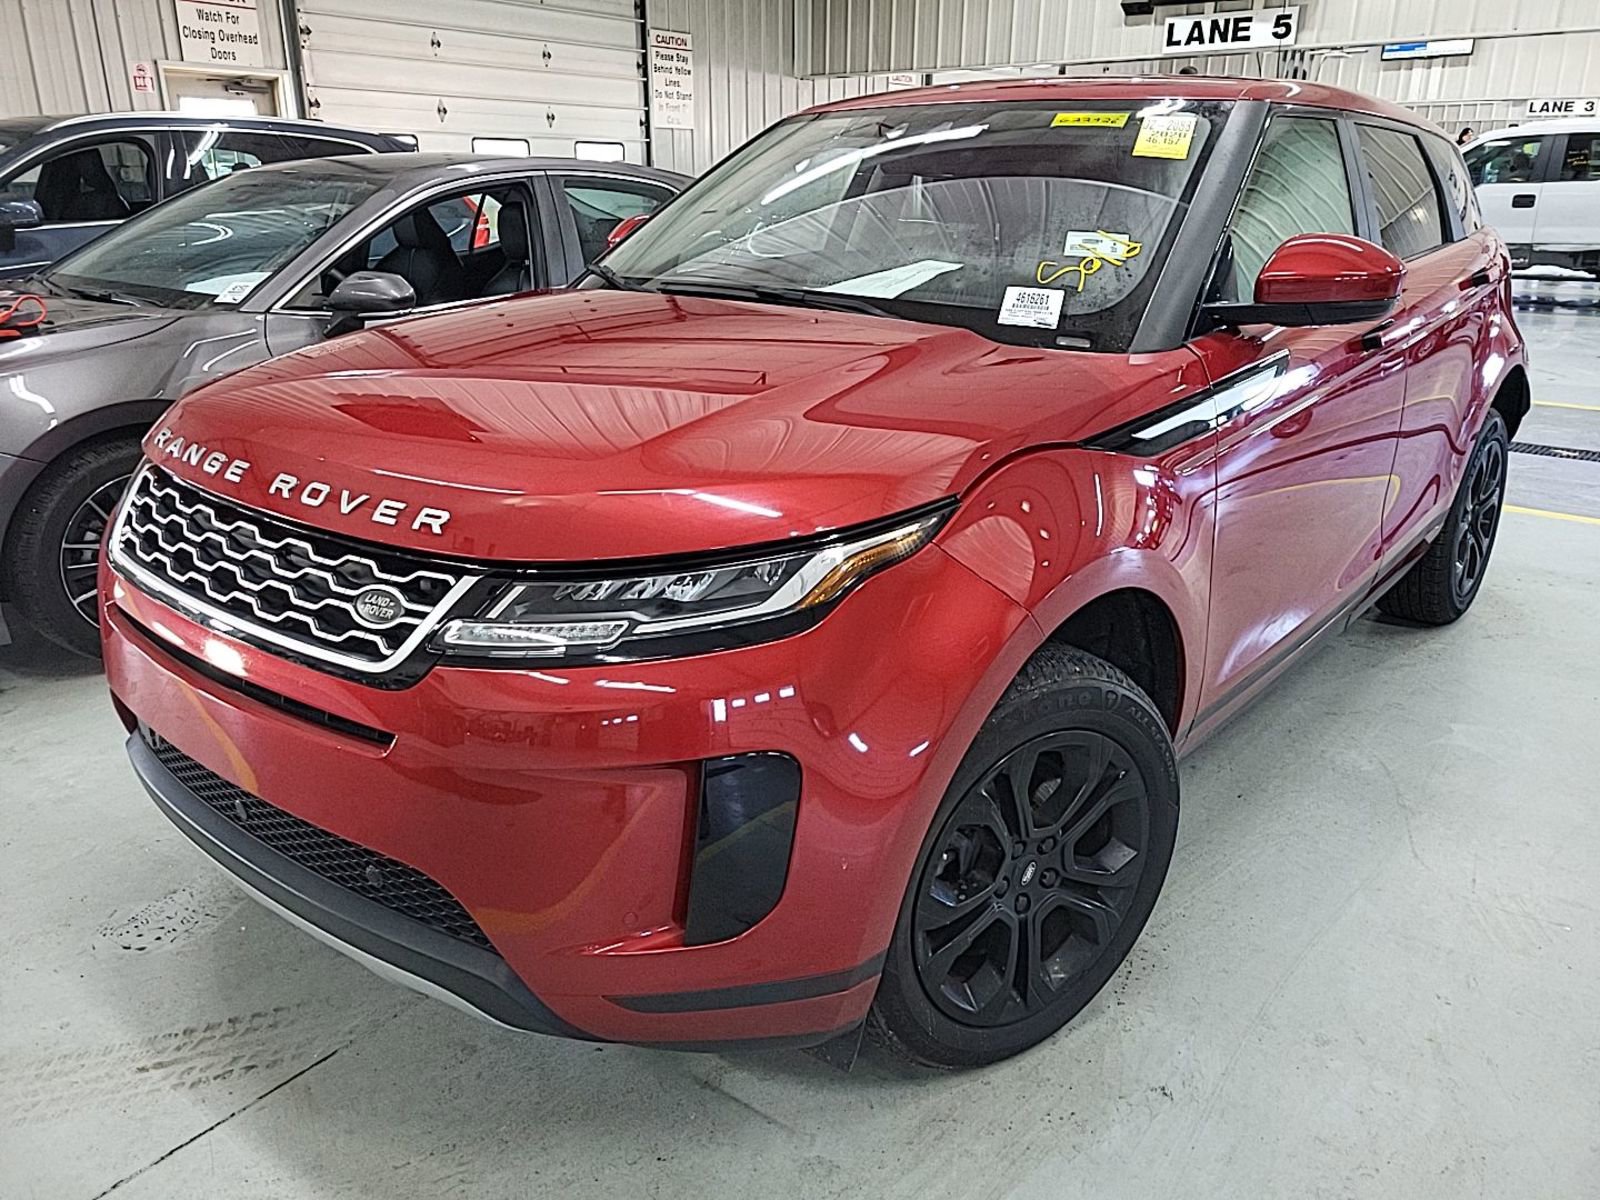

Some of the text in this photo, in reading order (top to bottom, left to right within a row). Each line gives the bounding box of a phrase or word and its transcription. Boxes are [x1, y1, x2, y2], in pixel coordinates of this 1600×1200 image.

[196, 8, 240, 24] Watch For
[182, 25, 258, 45] Closing Overhead
[1166, 13, 1293, 46] LANE 5
[655, 34, 688, 47] CAUTION
[210, 47, 237, 61] Doors
[655, 50, 689, 65] Please Stay
[1528, 101, 1596, 113] LANE 3
[153, 427, 451, 535] RANGE ROVER
